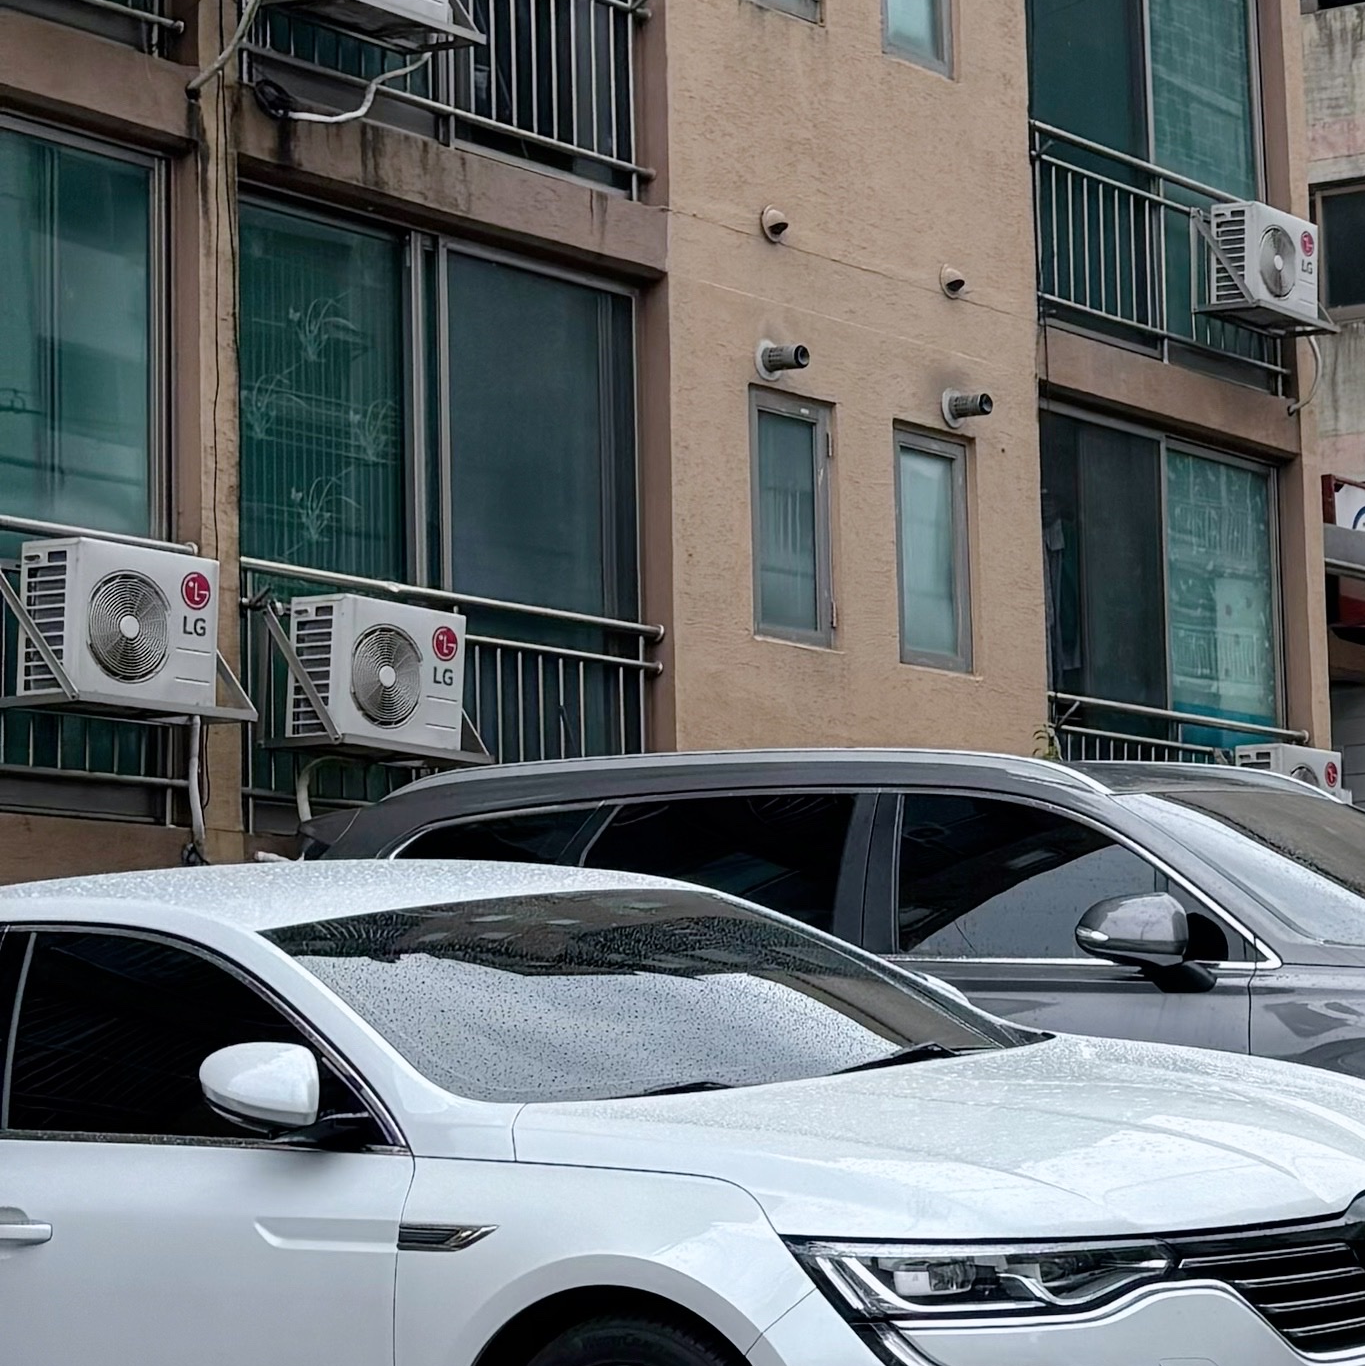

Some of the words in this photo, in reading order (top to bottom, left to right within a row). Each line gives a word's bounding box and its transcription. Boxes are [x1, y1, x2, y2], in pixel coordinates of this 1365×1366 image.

[1301, 258, 1313, 275] LG
[183, 615, 207, 637] LG
[433, 666, 454, 687] LG
